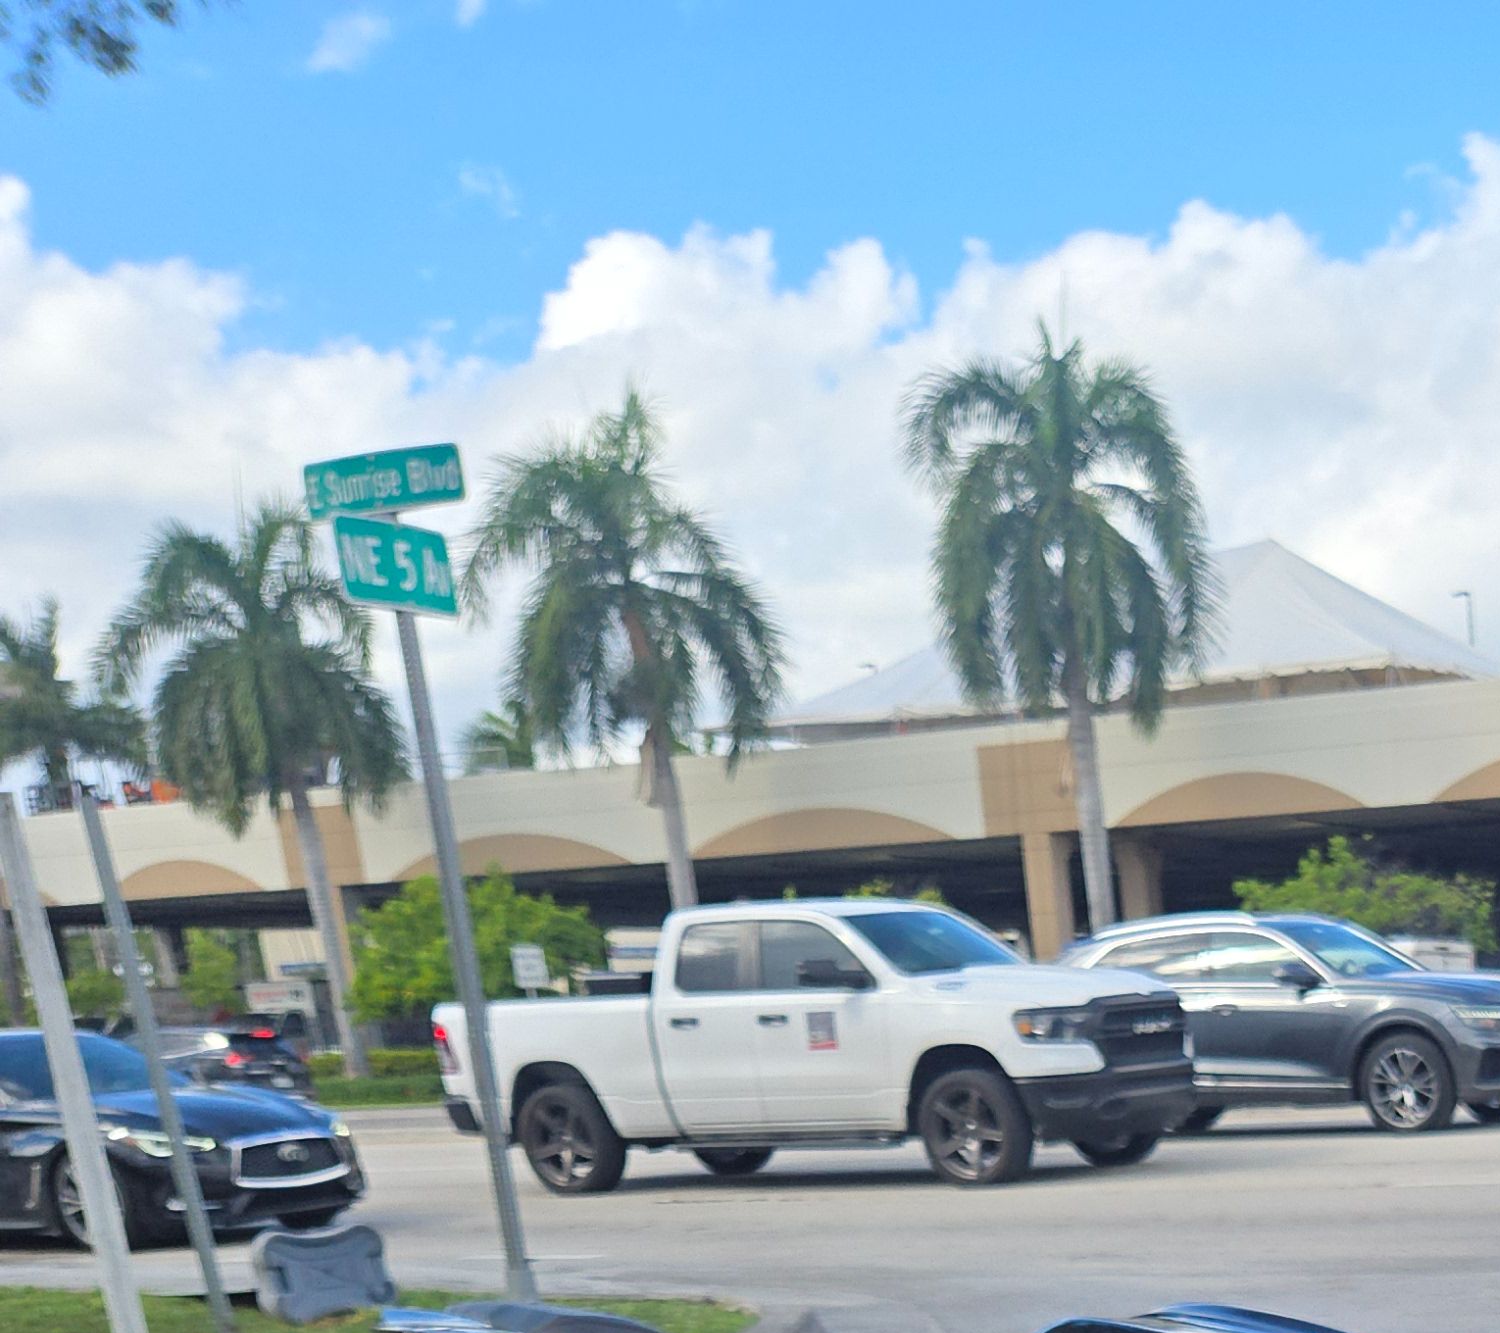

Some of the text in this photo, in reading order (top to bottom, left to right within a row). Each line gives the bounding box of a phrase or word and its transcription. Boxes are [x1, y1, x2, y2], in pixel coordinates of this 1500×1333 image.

[406, 457, 460, 495] Blvd
[340, 533, 389, 587] NE
[392, 540, 418, 592] 5
